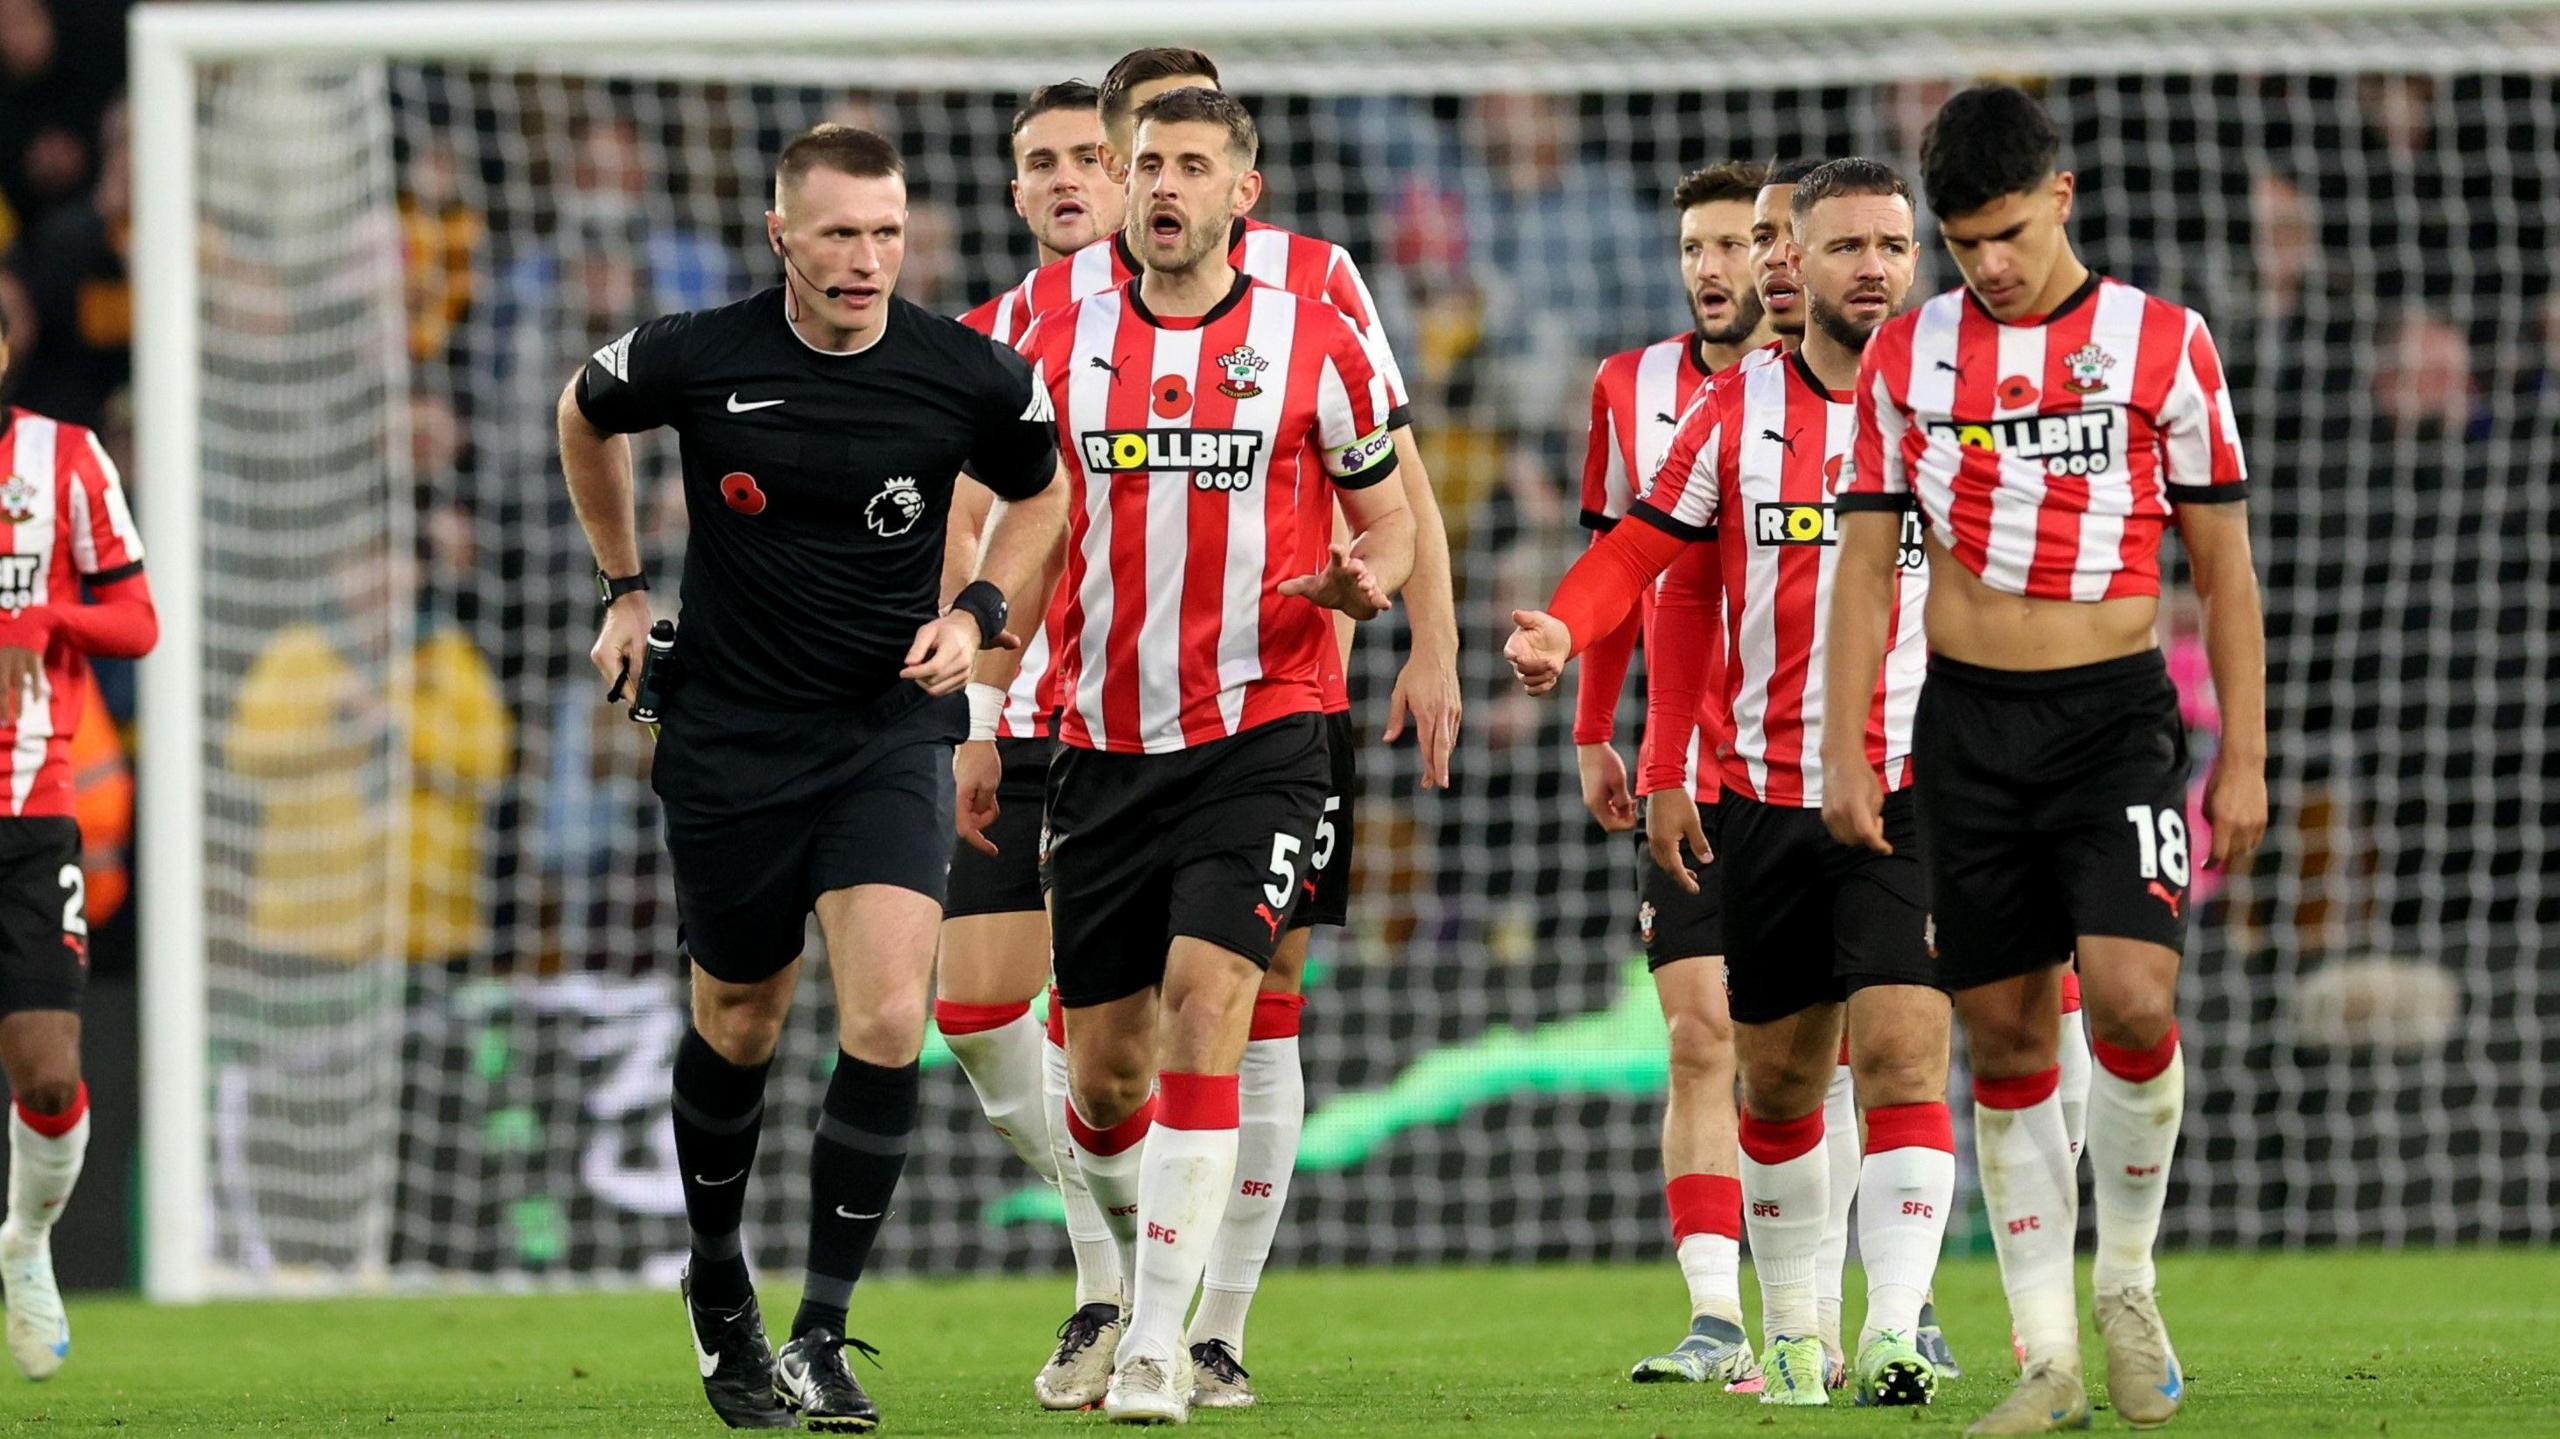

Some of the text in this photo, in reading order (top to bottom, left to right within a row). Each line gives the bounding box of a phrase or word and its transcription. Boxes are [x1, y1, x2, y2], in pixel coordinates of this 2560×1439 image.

[1085, 433, 1257, 469] ROLLBIT
[2126, 805, 2189, 887] 18
[1263, 832, 1301, 909] 5
[58, 863, 87, 936] 2
[1241, 1179, 1272, 1198] SFC
[1753, 1202, 1780, 1218] SFC
[1902, 1201, 1933, 1219] SFC
[1147, 1221, 1177, 1244] SFC
